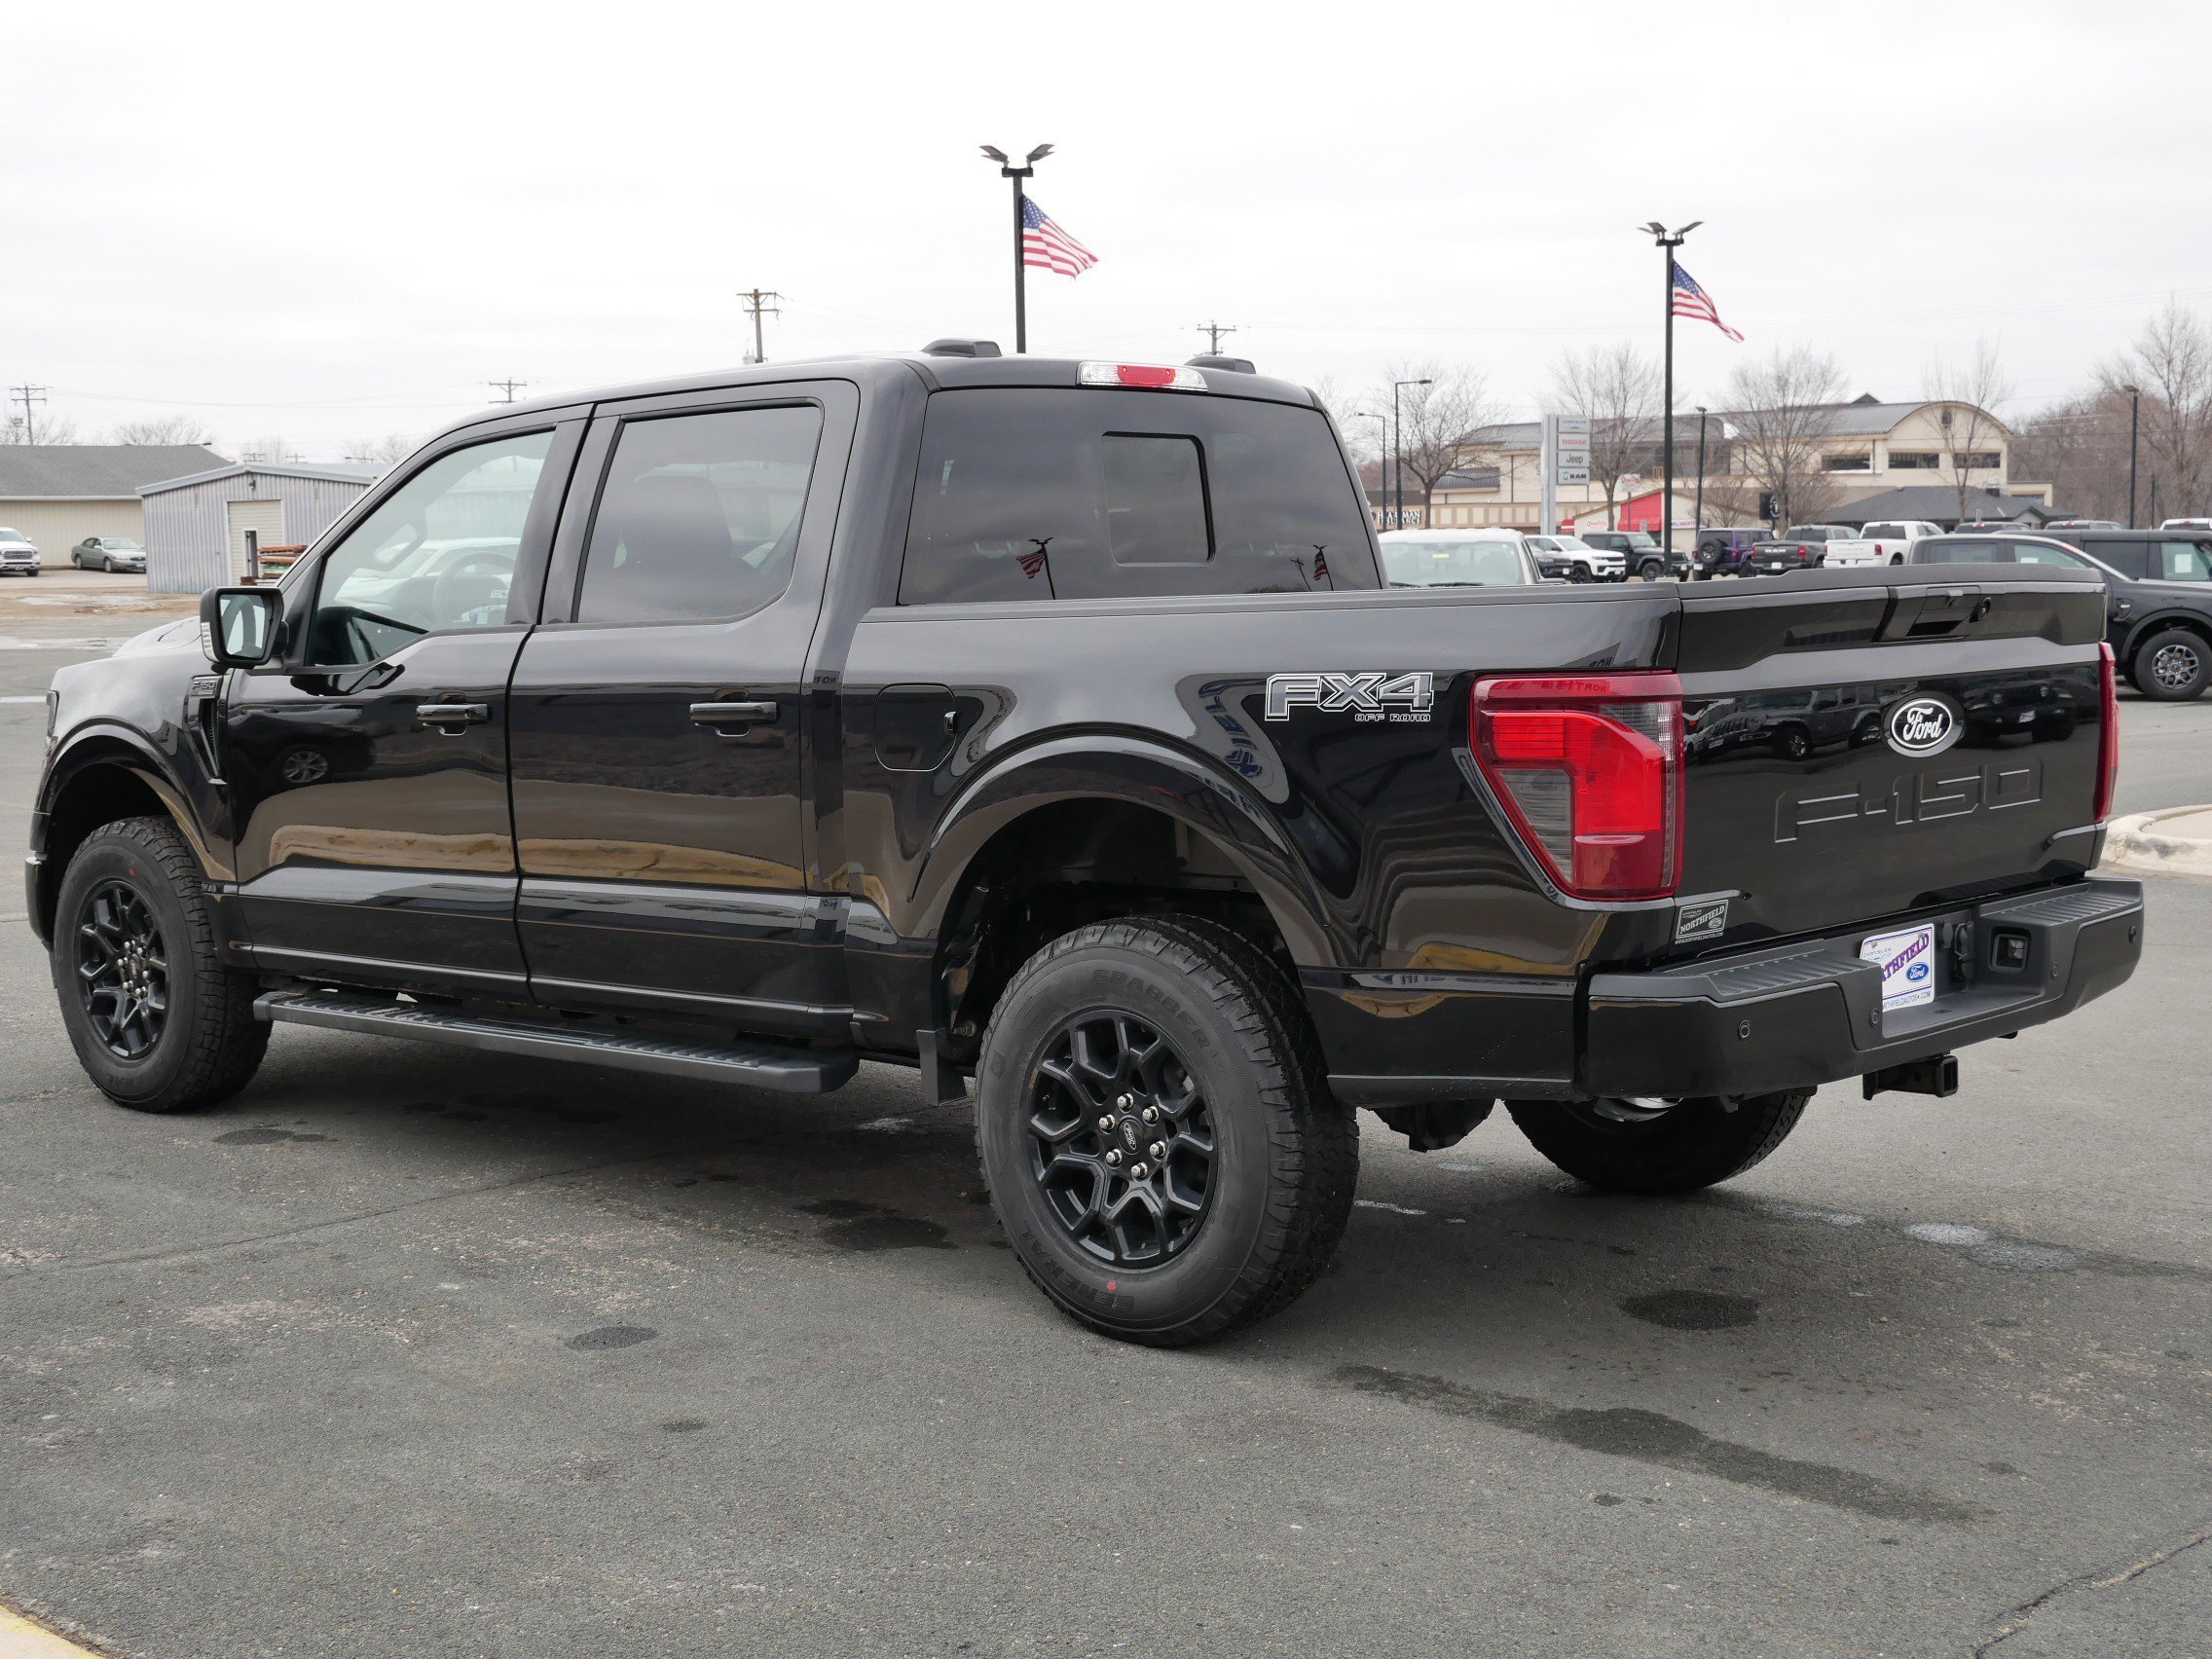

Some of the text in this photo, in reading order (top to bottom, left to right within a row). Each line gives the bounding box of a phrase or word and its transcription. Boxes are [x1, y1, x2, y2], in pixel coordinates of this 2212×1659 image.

[1566, 454, 1584, 465] Jeep
[1265, 672, 1434, 721] FX4
[1354, 713, 1431, 722] OFF ROAD
[1902, 707, 1942, 741] Ford
[1774, 756, 2043, 844] F-150
[1679, 905, 1725, 935] NORTHFIELD
[1880, 933, 1930, 982] THFIELD
[1909, 965, 1927, 979] Ford
[1091, 969, 1211, 1050] GRABBER
[1020, 1225, 1136, 1313] GENERAL
